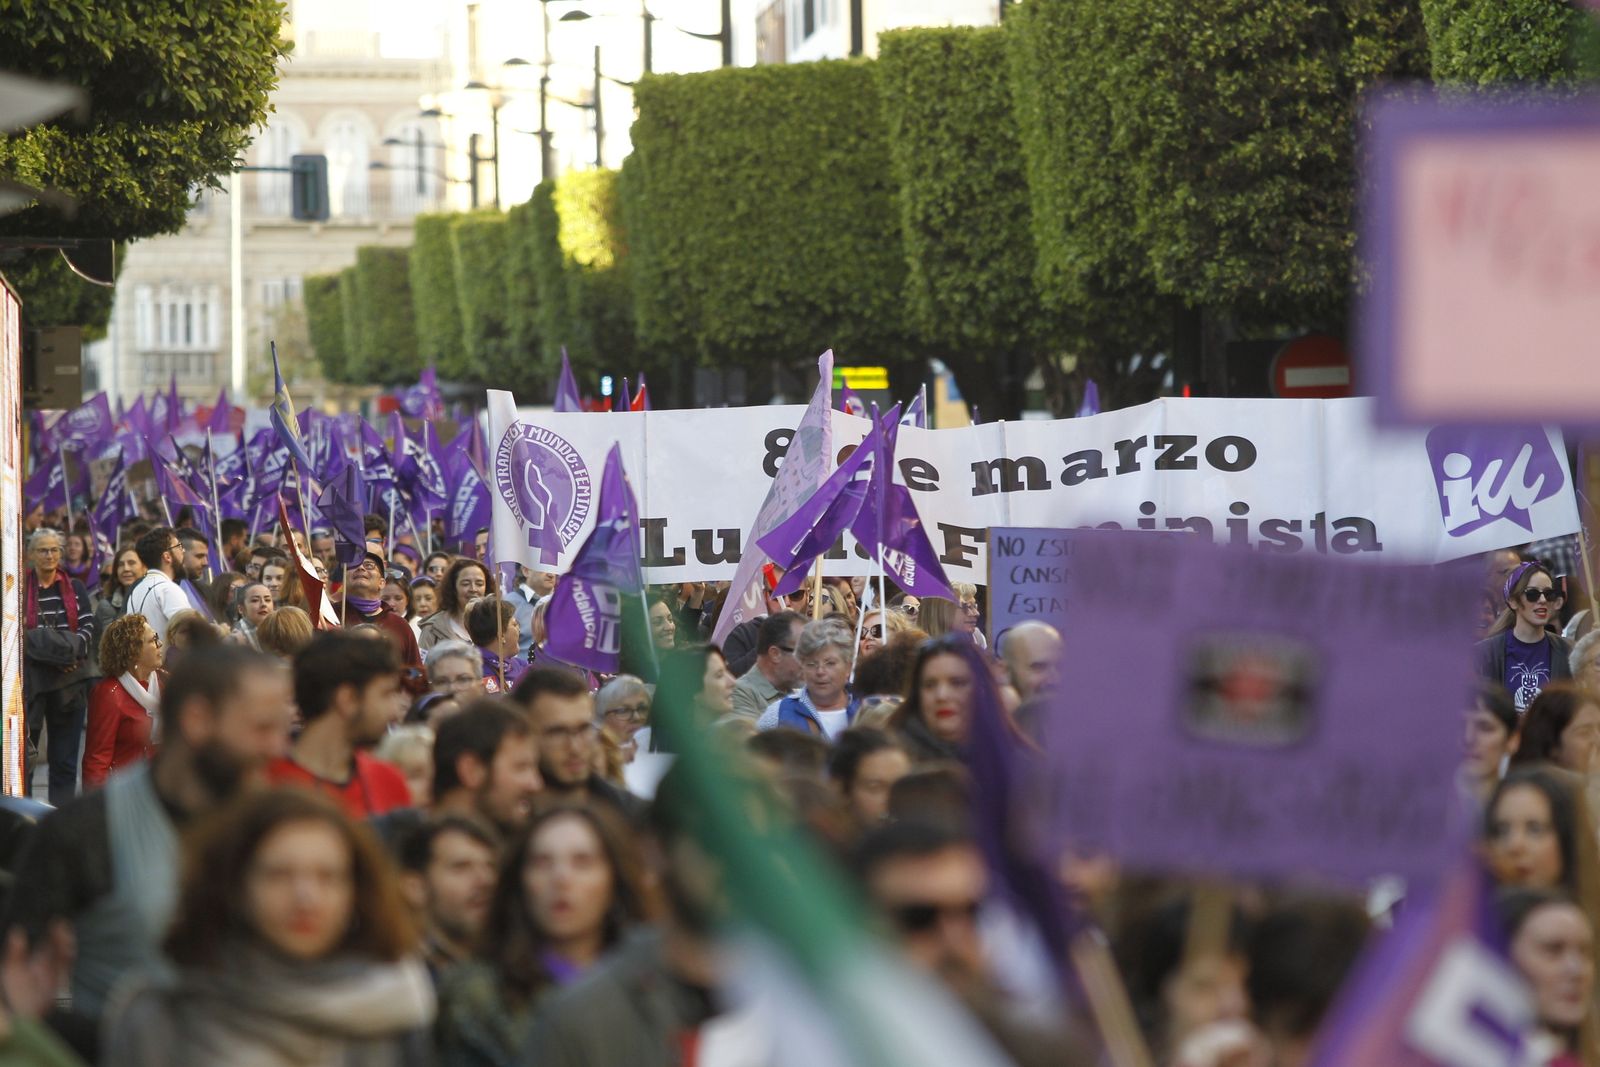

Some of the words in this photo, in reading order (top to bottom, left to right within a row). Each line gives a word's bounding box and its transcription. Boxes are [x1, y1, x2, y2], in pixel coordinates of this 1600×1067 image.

[970, 435, 1257, 497] marzo
[561, 468, 592, 545] FEMINISM
[997, 536, 1025, 557] NO
